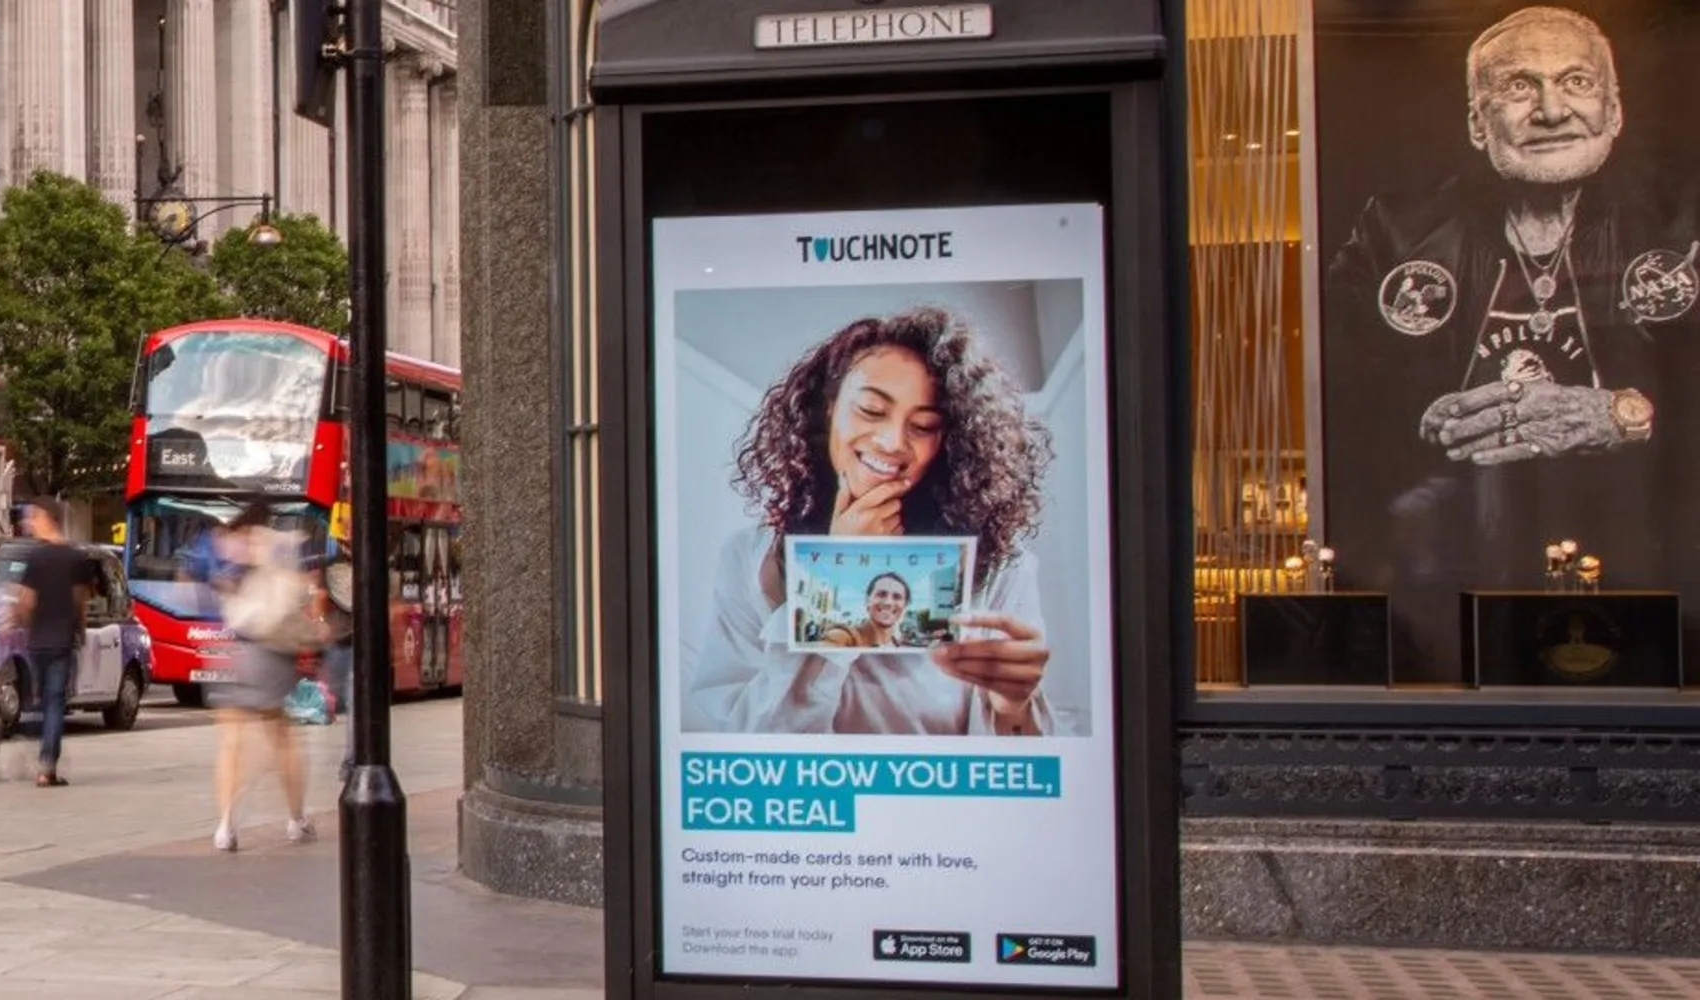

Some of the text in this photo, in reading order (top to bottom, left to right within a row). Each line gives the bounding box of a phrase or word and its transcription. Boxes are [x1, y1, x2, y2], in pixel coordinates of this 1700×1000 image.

[770, 8, 975, 44] TELEPHONE
[1629, 271, 1694, 301] NASA
[1478, 324, 1554, 359] APOL
[161, 448, 196, 466] East
[811, 551, 946, 567] VENICE
[686, 757, 1053, 795] SHOW HOW YOU FEEL,
[687, 797, 847, 827] FOR REAL
[681, 847, 978, 871] Custom-made cards sent with love,
[681, 870, 890, 891] straight from your phone.
[682, 925, 834, 944] Start your free trial today
[682, 941, 746, 954] Download
[749, 944, 769, 956] the
[901, 942, 965, 958] App Store
[1027, 946, 1091, 962] Google Play
